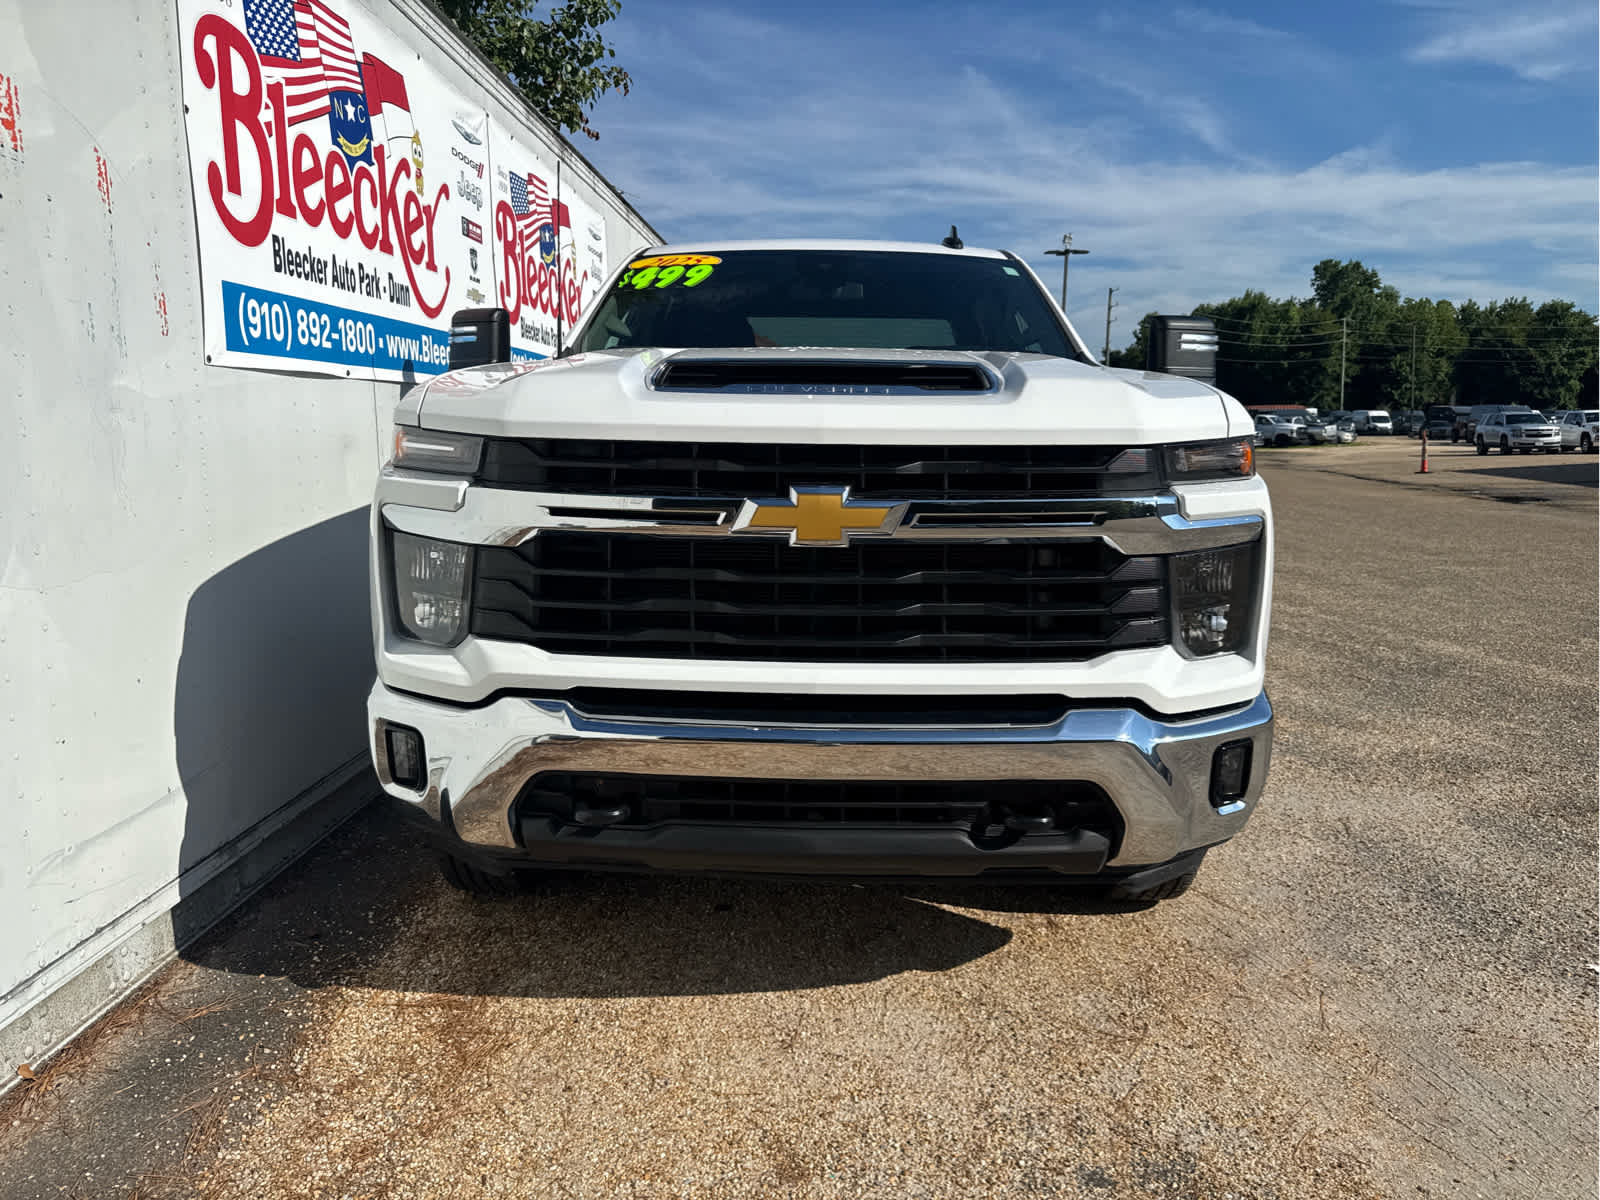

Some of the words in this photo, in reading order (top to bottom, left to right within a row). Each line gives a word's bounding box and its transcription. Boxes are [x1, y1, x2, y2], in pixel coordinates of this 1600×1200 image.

[333, 96, 344, 121] N
[357, 104, 366, 123] C
[193, 13, 450, 319] Bleecker
[451, 147, 480, 172] DODGE
[456, 170, 483, 212] Jeep
[271, 234, 328, 287] Bleecker
[331, 254, 357, 294] Auto
[358, 262, 382, 300] Park
[388, 272, 411, 308] Dunn
[239, 292, 292, 352] (910)
[296, 308, 376, 356] 892-1800
